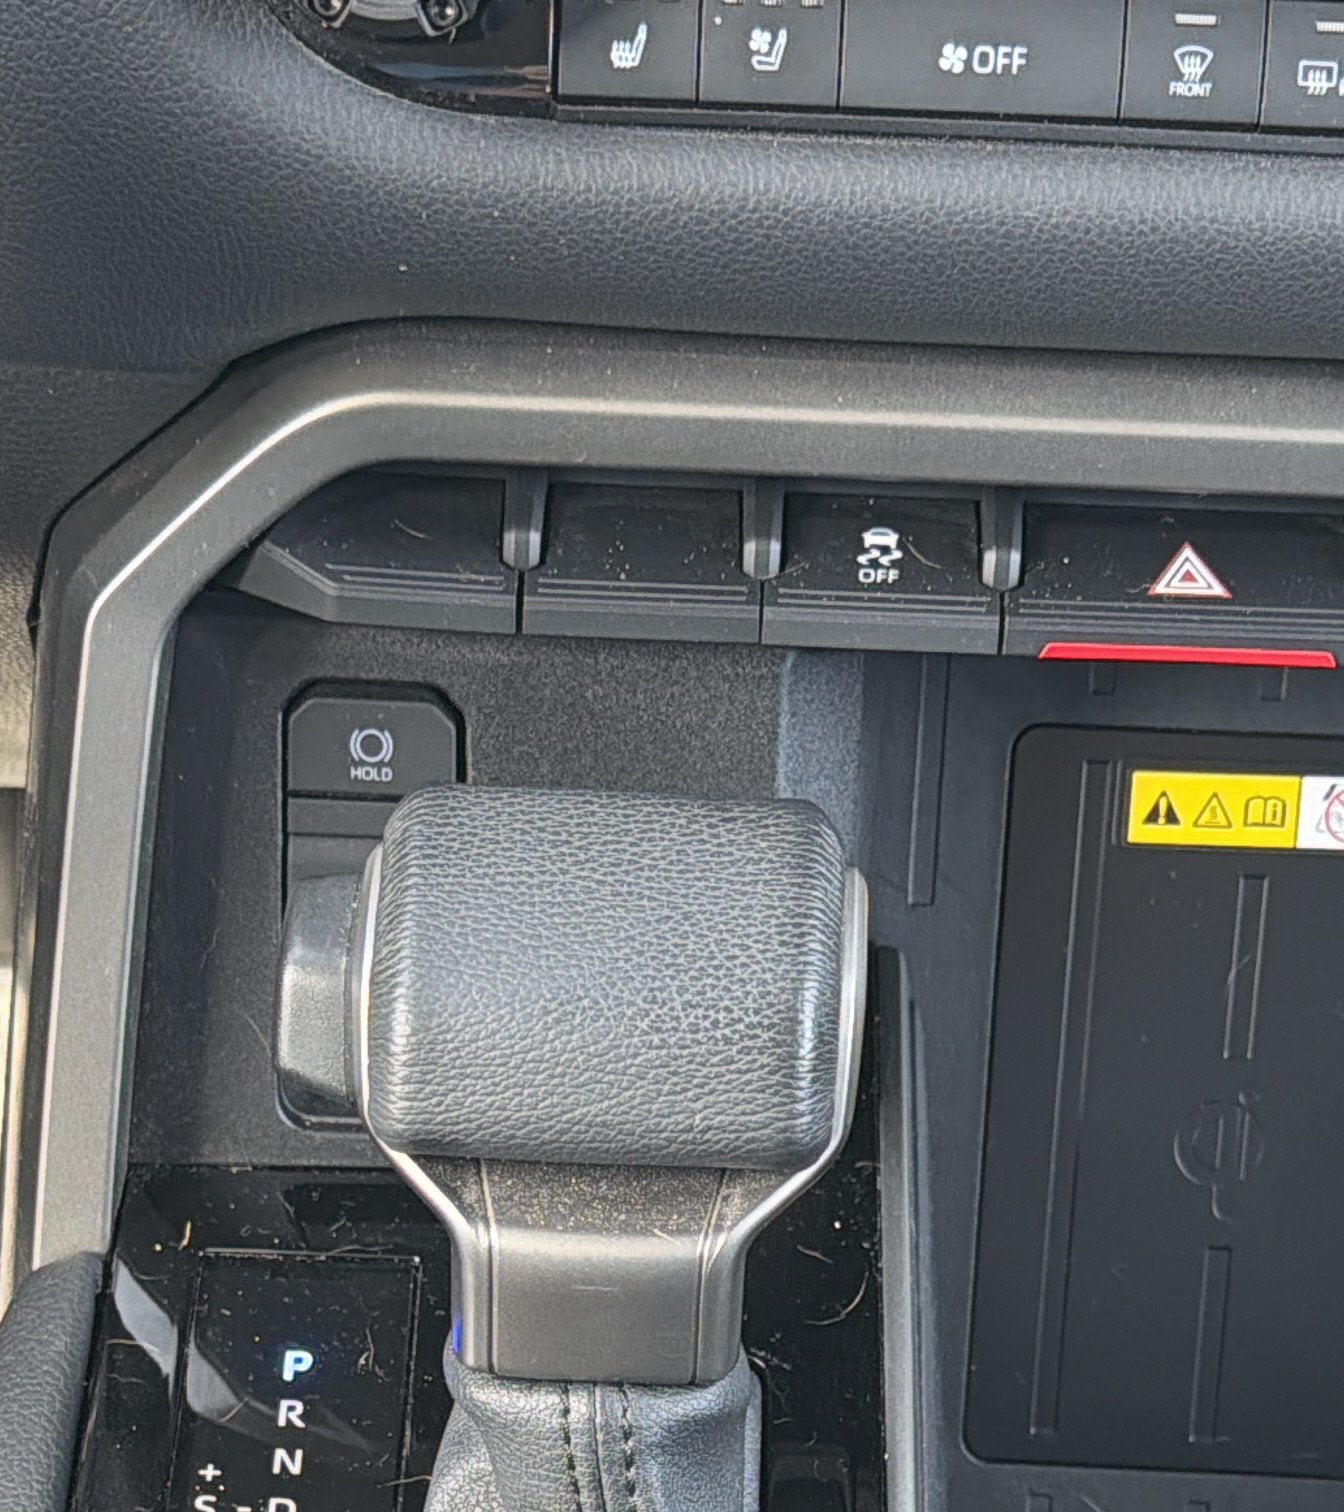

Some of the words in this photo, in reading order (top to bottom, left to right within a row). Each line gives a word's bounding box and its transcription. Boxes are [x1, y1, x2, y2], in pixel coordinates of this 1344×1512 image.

[972, 44, 1028, 75] OFF
[1168, 81, 1213, 97] FRONT
[858, 568, 900, 584] OFF
[350, 765, 393, 782] HOLD
[282, 1350, 314, 1382] P
[277, 1399, 306, 1428] R
[271, 1448, 304, 1476] N
